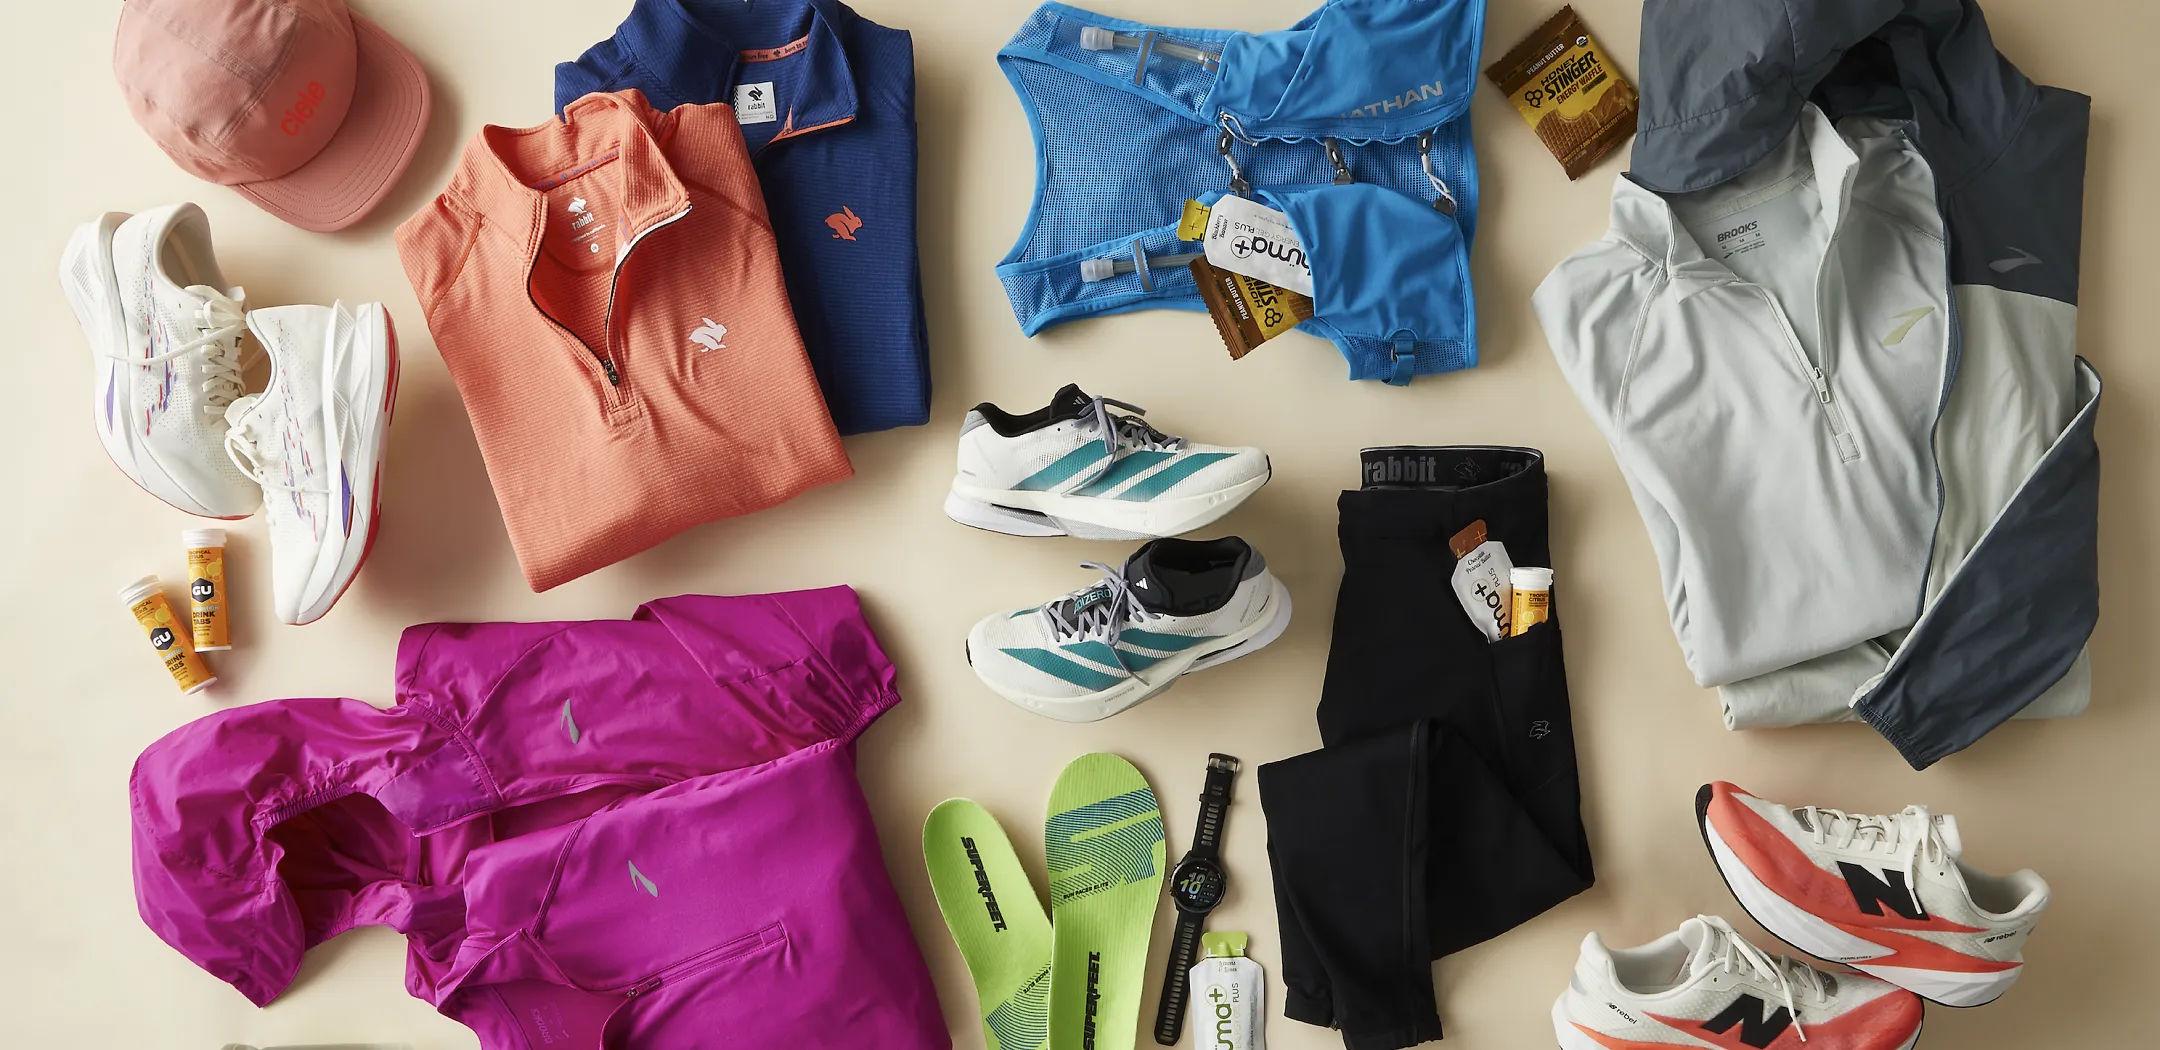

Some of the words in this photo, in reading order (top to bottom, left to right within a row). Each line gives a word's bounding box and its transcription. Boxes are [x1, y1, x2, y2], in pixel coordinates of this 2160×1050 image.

[1526, 58, 1547, 75] PEANUT
[1545, 43, 1565, 61] BUTTER
[1540, 54, 1576, 86] HONEY
[1544, 50, 1599, 101] STINGER
[1556, 82, 1580, 105] ENERGY
[1578, 64, 1603, 86] WAFFLE
[281, 81, 326, 137] ciele
[747, 102, 766, 110] rabbit
[1341, 80, 1444, 119] ATHAN
[571, 212, 596, 231] rabbit
[1234, 221, 1255, 234] PLUS
[1717, 220, 1758, 243] BROOKS
[1271, 231, 1300, 248] ENERGY
[1225, 276, 1239, 299] BUTTER
[1242, 275, 1263, 308] HONE
[1234, 298, 1250, 321] PEANUT
[1364, 456, 1437, 483] rabbit
[1488, 567, 1501, 588] PLUS
[192, 585, 212, 596] GU
[1073, 588, 1112, 615] ADIZERO
[153, 631, 171, 648] GU
[165, 652, 186, 667] DRINK
[169, 661, 185, 673] TABS
[960, 836, 1007, 933] SUPERFEET
[1180, 879, 1201, 895] 10
[1189, 872, 1206, 884] 10
[1996, 930, 2017, 940] rebel
[1083, 951, 1101, 1050] SUPERFEET
[1231, 982, 1240, 1003] PLUS
[530, 1008, 554, 1044] BROOKS
[1616, 1008, 1638, 1025] rebel
